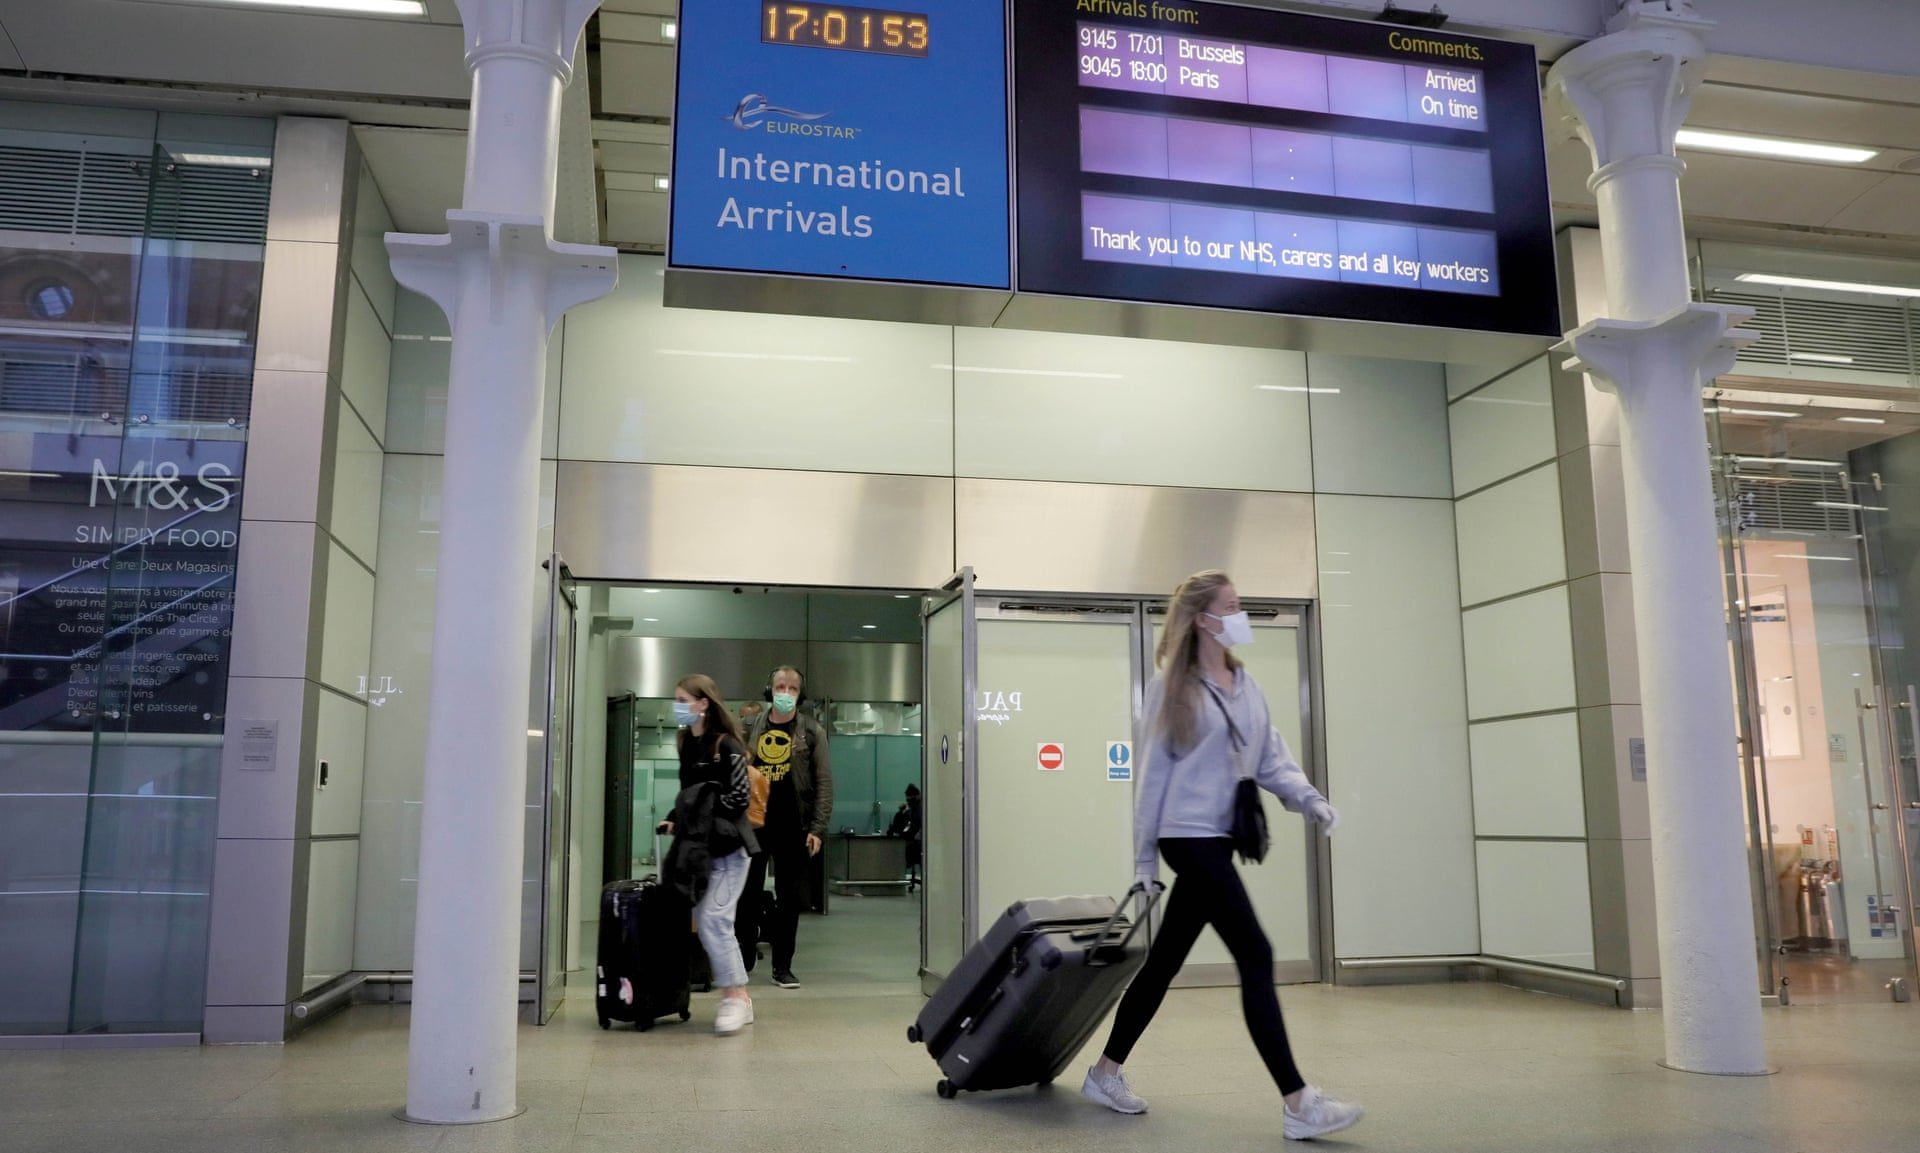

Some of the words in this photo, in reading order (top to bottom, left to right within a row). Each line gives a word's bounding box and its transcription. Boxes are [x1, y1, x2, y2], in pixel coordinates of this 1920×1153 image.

[1076, 0, 1147, 18] Arrivals
[1151, 4, 1200, 24] from:
[1080, 28, 1117, 50] 9145
[1128, 33, 1164, 55] 17:01
[1179, 39, 1245, 65] Brussels
[1388, 31, 1484, 60] Comments.
[1080, 55, 1121, 78] 9045
[1129, 61, 1168, 83] 18:00
[1179, 66, 1220, 89] Paris
[1425, 69, 1477, 93] Arrived
[1421, 95, 1444, 116] On
[1448, 99, 1479, 119] time
[766, 121, 856, 139] EUROSTAR
[717, 148, 965, 197] International
[716, 197, 873, 238] Arrivals
[1090, 226, 1142, 251] Thank
[1147, 235, 1178, 257] you
[1184, 235, 1201, 256] to
[1207, 242, 1234, 259] our
[1240, 240, 1277, 267] NHS,
[1281, 250, 1333, 269] carers
[1339, 252, 1367, 272] and
[1373, 254, 1389, 274] all
[1393, 255, 1421, 281] key
[1427, 261, 1490, 283] workers
[89, 458, 232, 513] M&S
[75, 525, 162, 545] SIMPLY
[168, 528, 237, 548] FOOD
[72, 556, 99, 570] Une
[141, 559, 176, 572] Deux
[176, 561, 235, 575] Magasins
[55, 597, 87, 608] grand
[58, 622, 75, 633] Ou
[77, 625, 104, 634] nous
[167, 612, 186, 622] The
[176, 652, 220, 662] cravates
[132, 689, 154, 699] vins
[133, 702, 144, 712] et
[147, 702, 198, 713] patisserie
